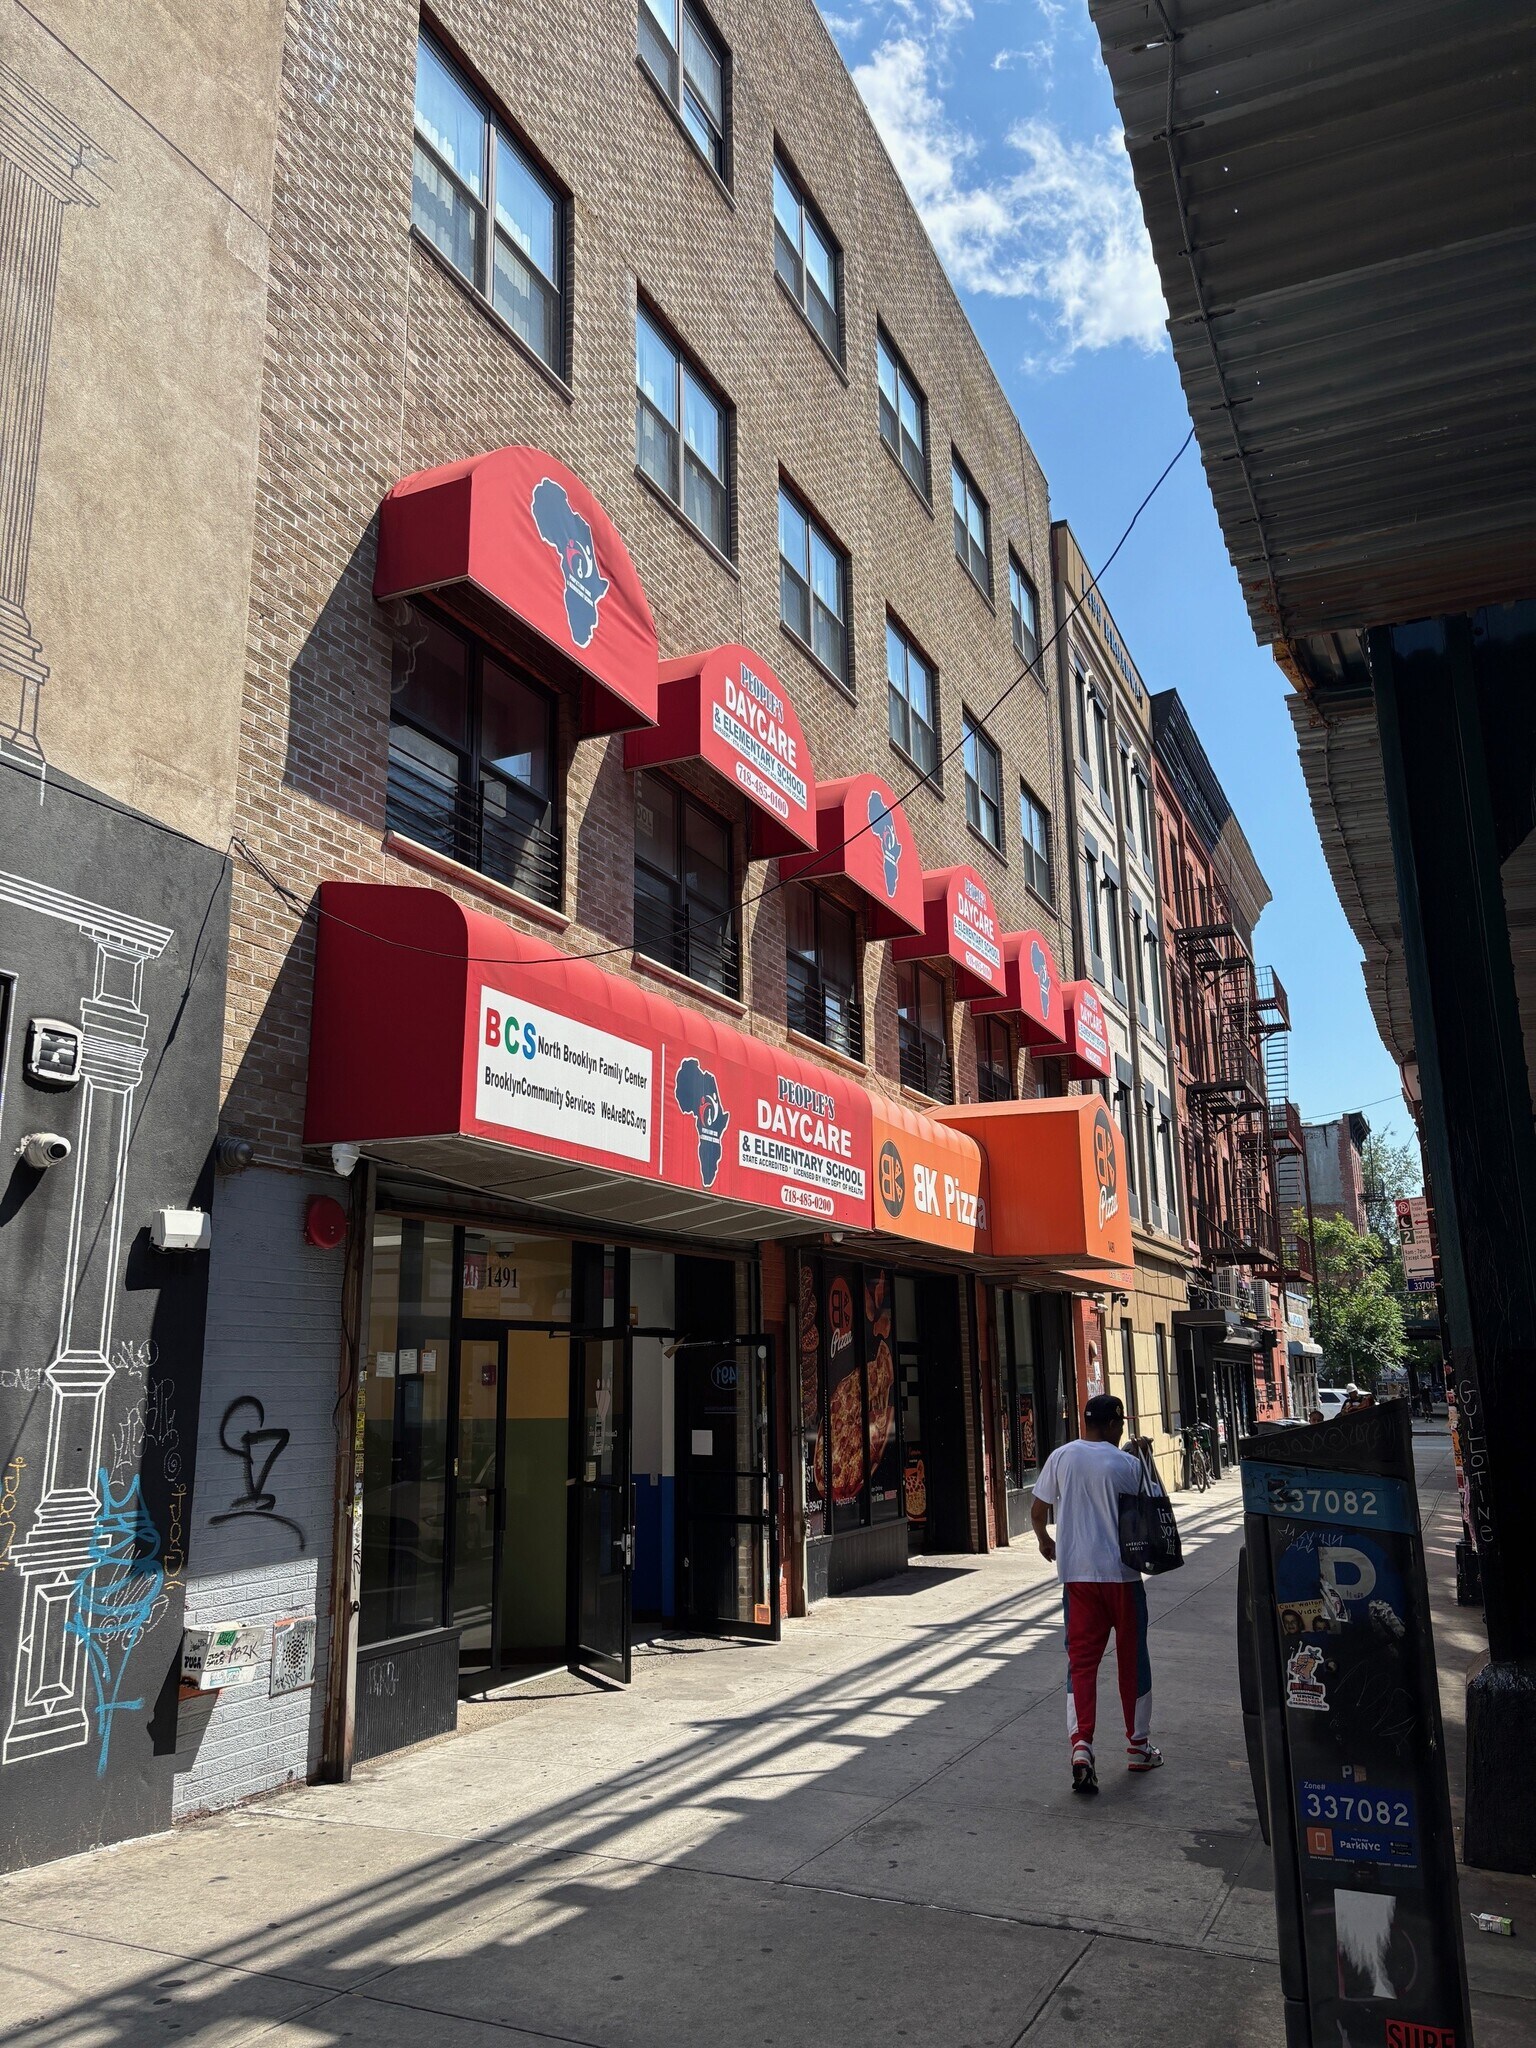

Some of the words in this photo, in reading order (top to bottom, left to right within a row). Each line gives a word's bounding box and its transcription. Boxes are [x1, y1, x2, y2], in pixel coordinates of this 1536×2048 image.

[740, 662, 784, 725] PEOPLE'S
[725, 673, 797, 770] DAYCARE
[714, 707, 721, 723] &
[723, 714, 776, 771] ELEMENTARY
[777, 763, 806, 799] SCHOOL
[738, 764, 787, 815] 718-485-0100
[958, 892, 995, 941] DAYCARE
[485, 1007, 537, 1060] BCS
[538, 1035, 561, 1060] North
[563, 1044, 597, 1074] Brooklyn
[599, 1057, 623, 1085] Family
[624, 1066, 648, 1090] Center
[485, 1066, 564, 1110] BrooklynCommunity
[565, 1090, 596, 1115] Services
[601, 1101, 647, 1135] WeAreBCS.org
[777, 1075, 835, 1121] PEOPLE'S
[757, 1099, 852, 1158] DAYCARE
[742, 1135, 751, 1152] &
[754, 1138, 824, 1173] ELEMENTARY
[826, 1161, 863, 1187] SCHOOL
[742, 1154, 758, 1165] STATE
[758, 1157, 789, 1173] ACCREDITED
[793, 1167, 815, 1182] LICENSED
[821, 1174, 831, 1186] NYC
[848, 1183, 863, 1196] HEALTH
[783, 1188, 832, 1212] 718-485-0200
[913, 1163, 941, 1217] BK
[943, 1173, 987, 1230] Pizza
[1098, 1185, 1119, 1232] Pizza
[1403, 1231, 1412, 1244] 2
[488, 1266, 518, 1288] 1491
[1317, 1546, 1377, 1600] P
[1303, 1781, 1326, 1790] Zone#
[1307, 1793, 1410, 1827] 337082
[1340, 1840, 1381, 1852] ParkNYC
